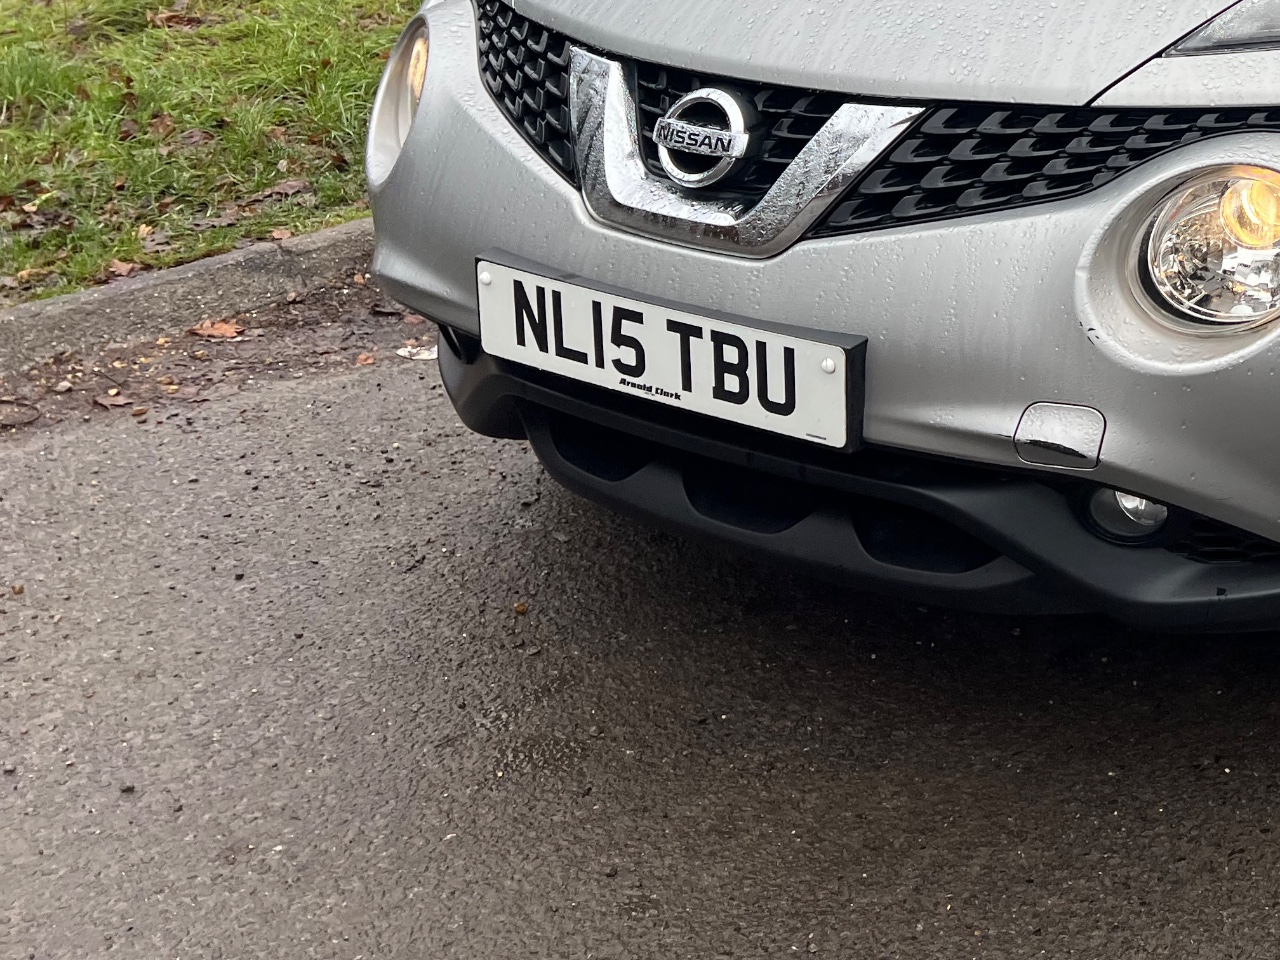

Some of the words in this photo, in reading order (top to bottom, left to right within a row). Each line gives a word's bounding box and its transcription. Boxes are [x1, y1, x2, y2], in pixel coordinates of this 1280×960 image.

[659, 124, 732, 152] NISSAN
[513, 279, 646, 378] NL15
[666, 319, 796, 416] TBU
[619, 377, 653, 393] Arnold
[655, 387, 681, 401] Clark
